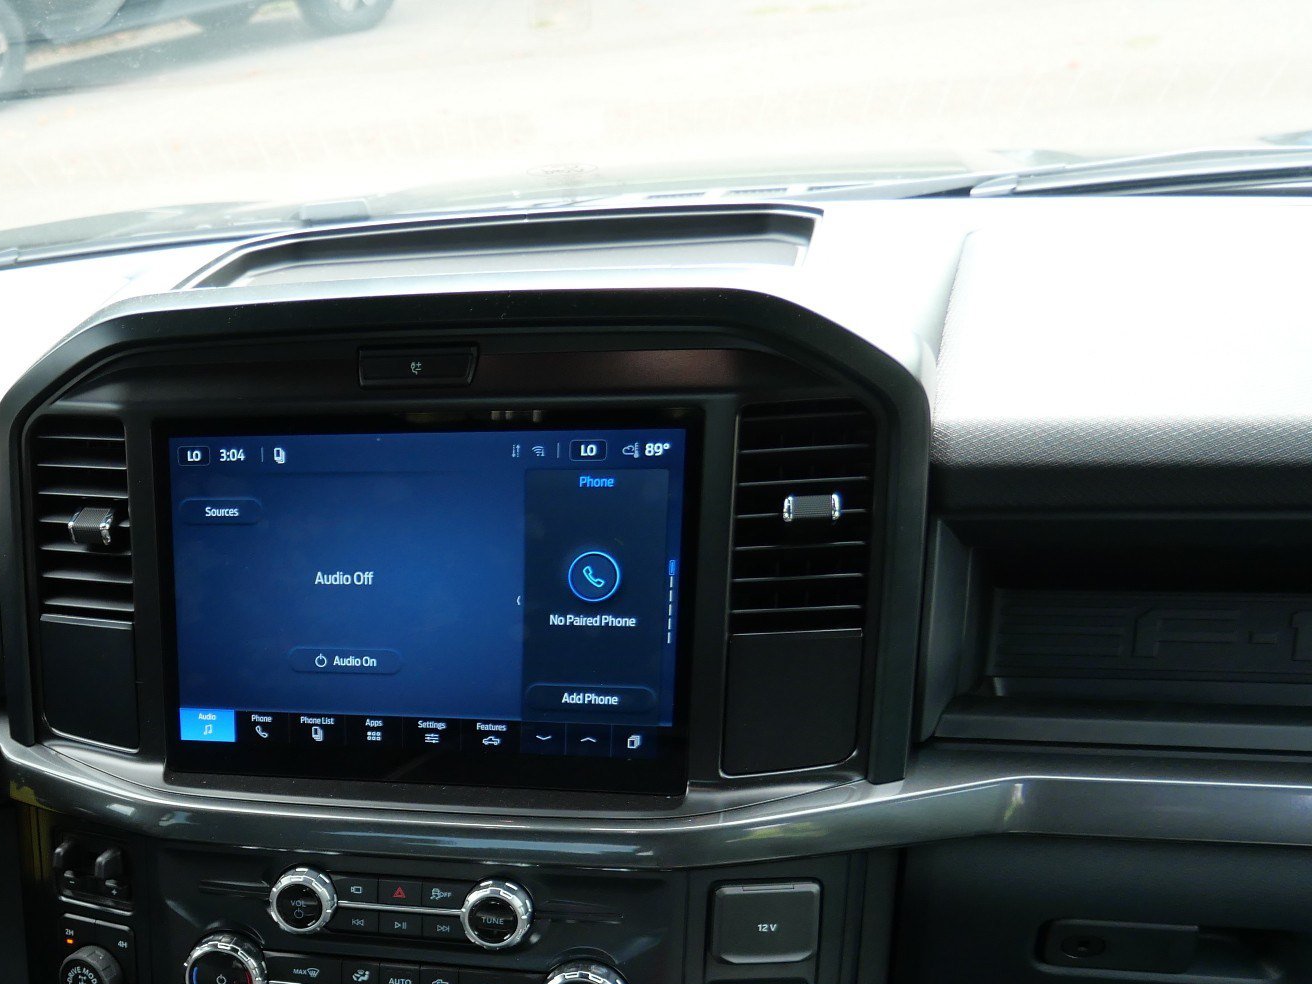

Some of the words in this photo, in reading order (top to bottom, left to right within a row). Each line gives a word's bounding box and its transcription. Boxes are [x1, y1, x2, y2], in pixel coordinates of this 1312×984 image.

[580, 444, 597, 456] LO
[644, 443, 670, 456] 89°
[187, 450, 202, 462] LO
[219, 449, 245, 462] 3:04
[579, 476, 614, 488] Phone
[205, 506, 239, 517] Sources
[314, 571, 352, 585] Audio
[353, 571, 374, 585] Off
[549, 615, 565, 626] No
[566, 615, 600, 626] Paired
[601, 615, 636, 627] Phone
[333, 656, 361, 667] Audio
[362, 656, 377, 667] On
[561, 693, 583, 704] Add
[584, 693, 619, 705] Phone
[198, 713, 217, 721] Audio
[251, 714, 272, 723] Phone
[300, 716, 320, 725] Phone
[321, 717, 334, 725] List
[365, 718, 383, 728] Apps
[417, 720, 446, 730] Settings
[476, 723, 507, 732] Features
[481, 917, 504, 925] TUNE
[757, 924, 768, 932] 12
[768, 924, 777, 932] V
[118, 940, 128, 948] 4H
[67, 966, 81, 983] DRIVE
